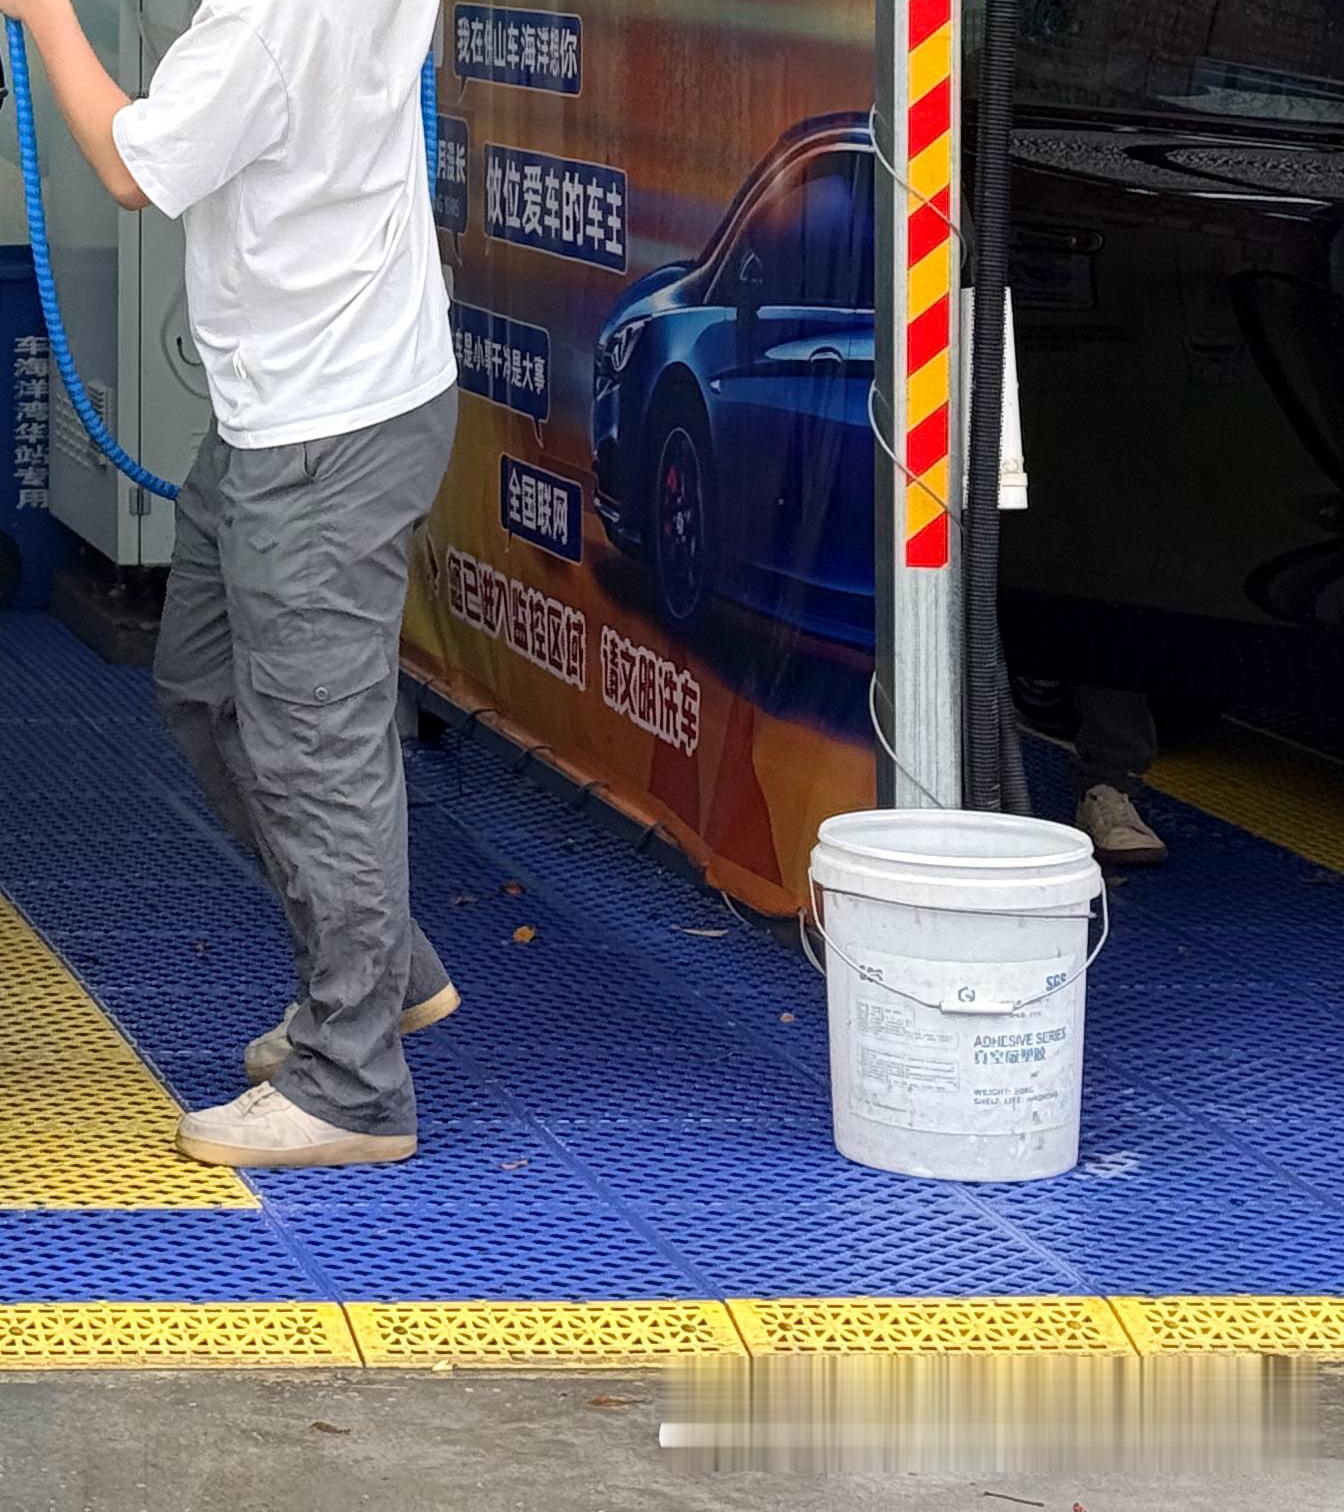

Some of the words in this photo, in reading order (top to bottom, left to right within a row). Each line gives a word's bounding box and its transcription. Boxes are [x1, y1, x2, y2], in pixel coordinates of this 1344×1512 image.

[508, 467, 569, 546] 全国联网
[604, 629, 700, 751] 请文明洗车
